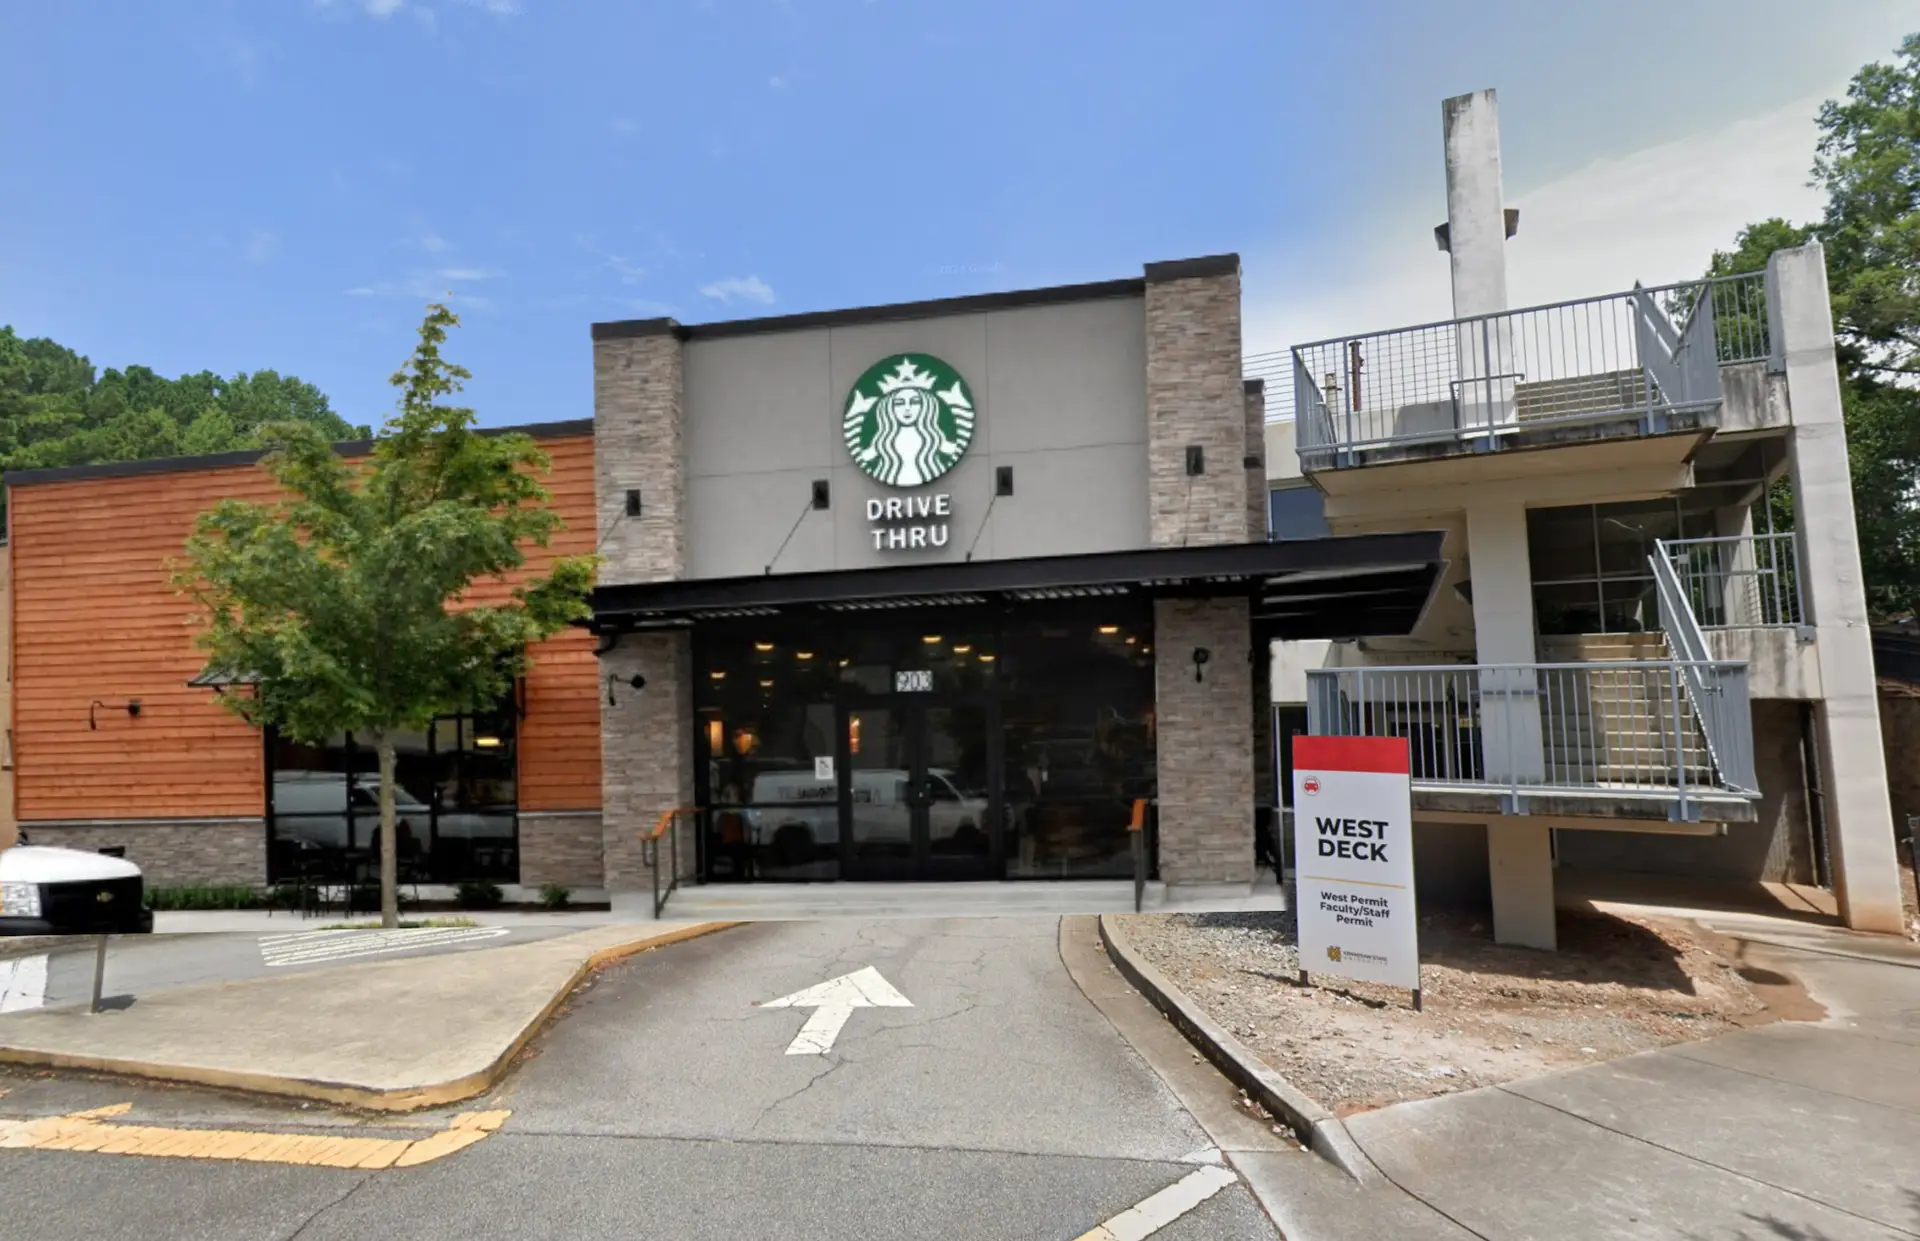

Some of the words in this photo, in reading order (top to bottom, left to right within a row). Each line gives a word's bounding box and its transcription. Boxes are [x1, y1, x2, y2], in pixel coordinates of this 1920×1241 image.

[867, 495, 950, 520] DRIVE
[873, 525, 949, 550] THRU
[1316, 816, 1389, 840] WEST
[1318, 839, 1389, 863] DECK
[1320, 902, 1390, 918] Faculty/Staff
[1321, 891, 1348, 902] West
[1350, 895, 1388, 908] Permit
[1336, 914, 1374, 927] Permit
